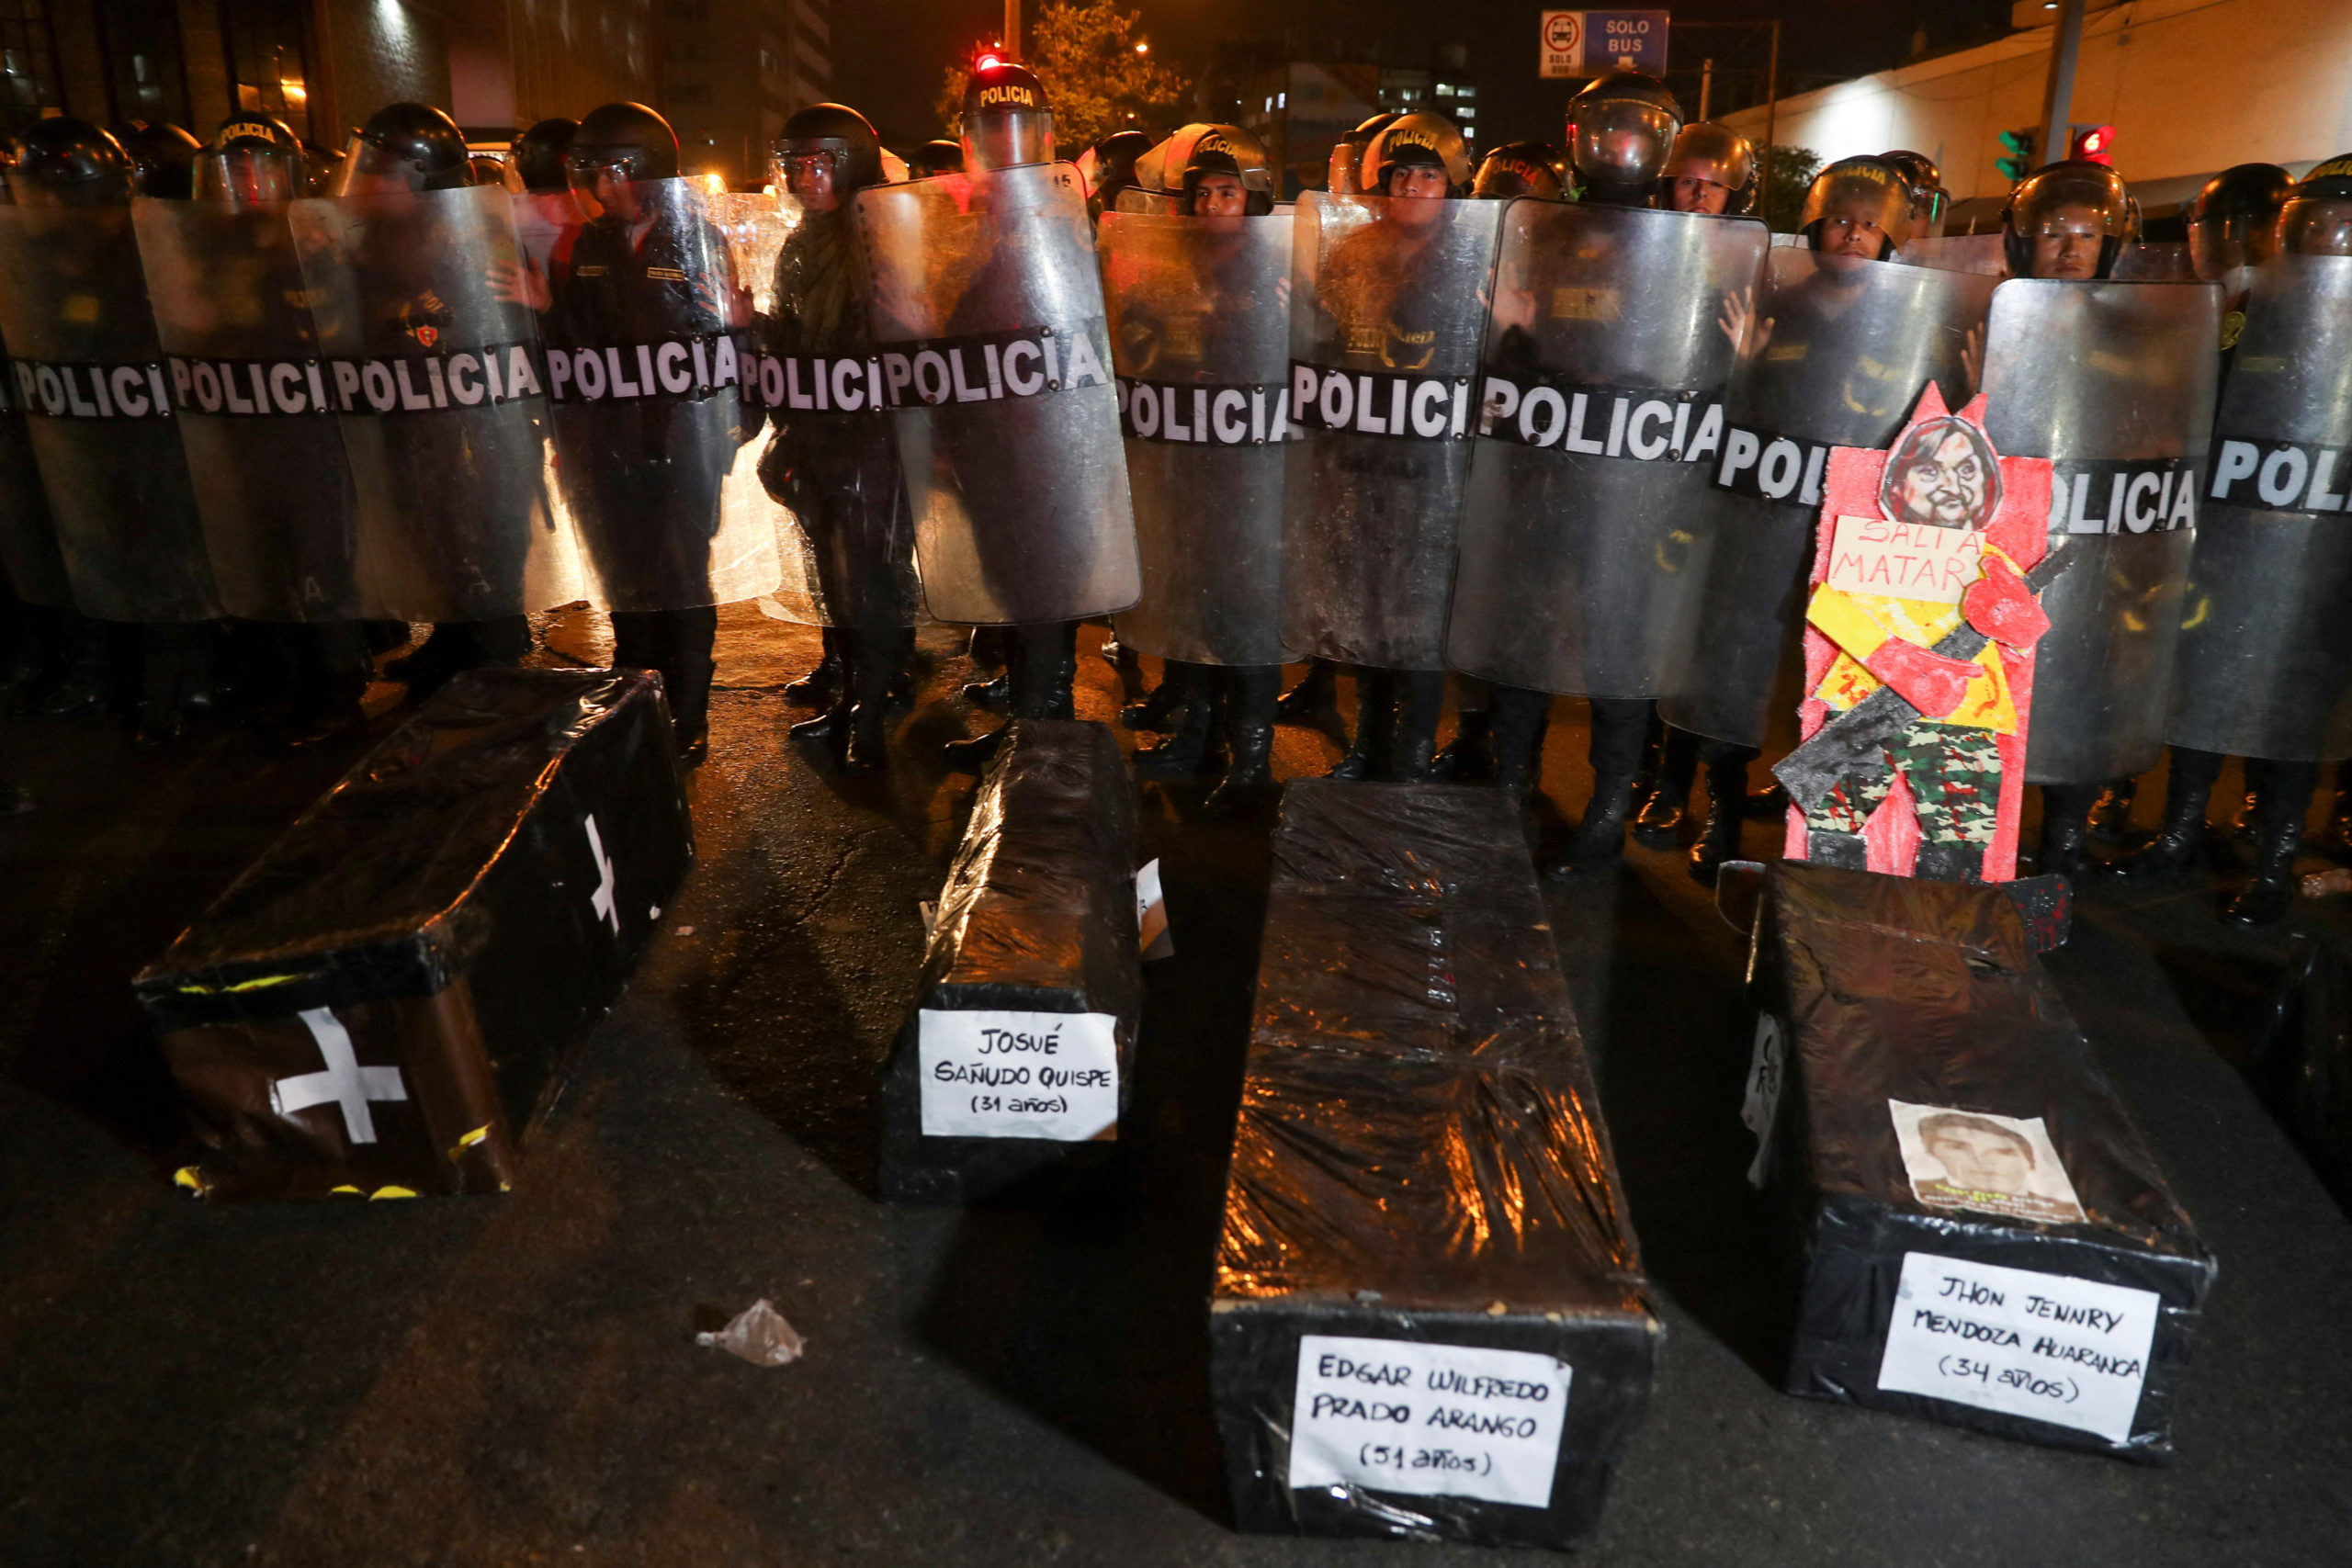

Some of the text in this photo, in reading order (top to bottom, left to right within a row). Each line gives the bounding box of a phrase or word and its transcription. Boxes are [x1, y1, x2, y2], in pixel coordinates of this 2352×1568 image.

[1605, 20, 1649, 34] SOLO
[1608, 39, 1643, 52] BUS
[980, 85, 1034, 107] POLICIA
[218, 123, 277, 149] POLICIA
[1053, 175, 1072, 188] 15
[15, 361, 171, 418] POLICI
[169, 356, 327, 414] POLICI
[332, 345, 542, 412] POLICIA
[547, 335, 739, 400] POLICIA
[741, 353, 884, 412] POLICI
[883, 333, 1108, 406] POLICIA
[1294, 365, 1470, 438] POLICI
[1718, 428, 1826, 505] POL
[2211, 439, 2352, 513] POL
[2048, 469, 2196, 535] LICIA
[1858, 519, 1981, 555] SALI A
[1831, 552, 1966, 592] MATAR
[978, 1022, 1063, 1054] JOSUÉ
[934, 1060, 1112, 1089] SAÑUDO QUISPE
[971, 1095, 1068, 1113] (31 años)
[1939, 1276, 2124, 1334] JHON JENNRY
[1912, 1309, 2021, 1348] MENDOZA
[1318, 1354, 1549, 1402] EDGAR WILFREDO
[1939, 1354, 2080, 1404] (34 años)
[1310, 1393, 1537, 1438] PRADO ARANGO
[1359, 1441, 1404, 1468] (51
